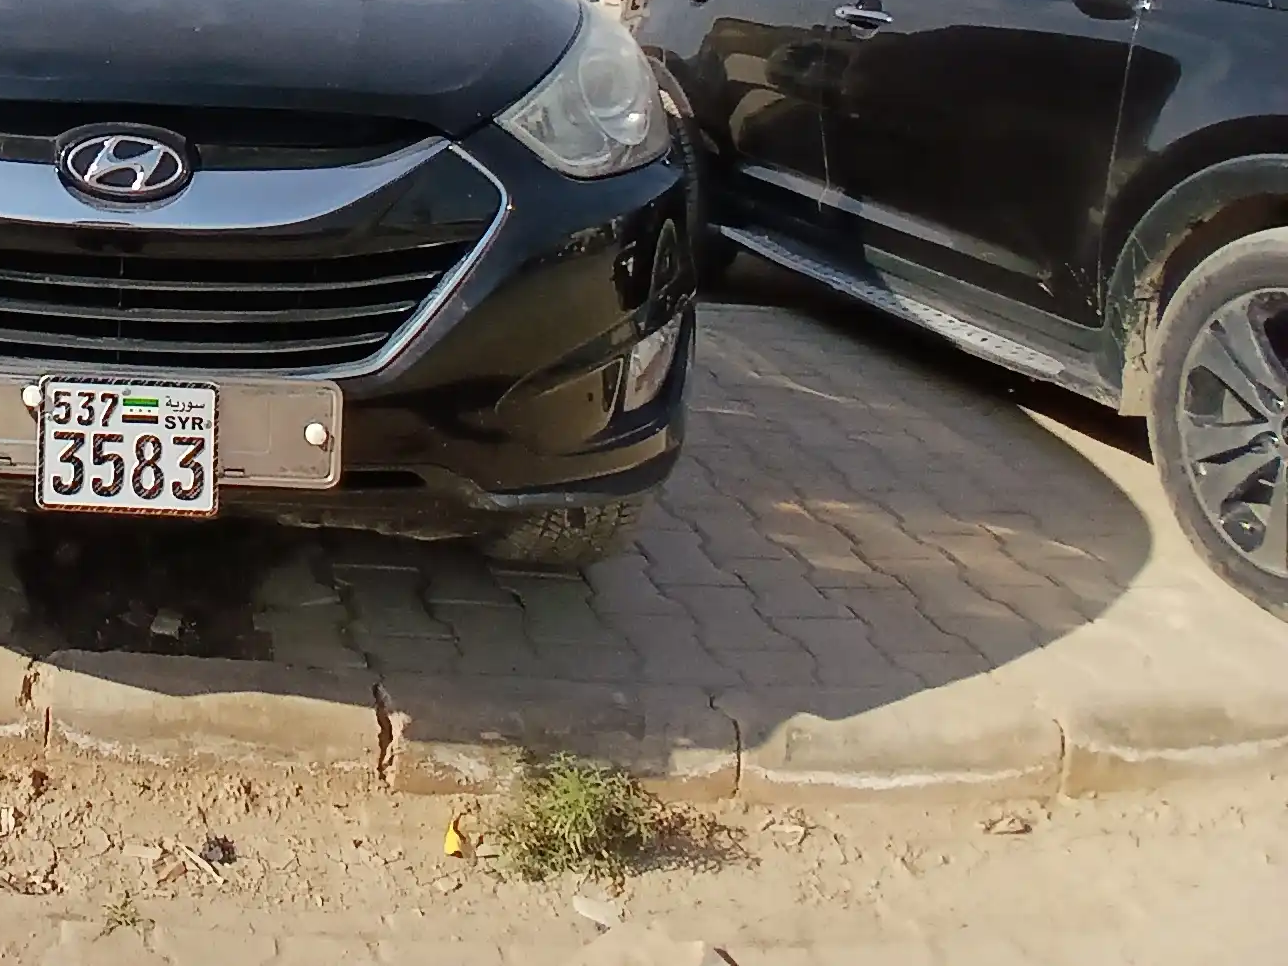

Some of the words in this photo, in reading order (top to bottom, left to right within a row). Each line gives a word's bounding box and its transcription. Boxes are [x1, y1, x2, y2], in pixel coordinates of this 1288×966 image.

[52, 390, 120, 427] 537
[165, 395, 205, 413] سورية
[164, 415, 204, 431] SYR
[52, 430, 206, 501] 3583
